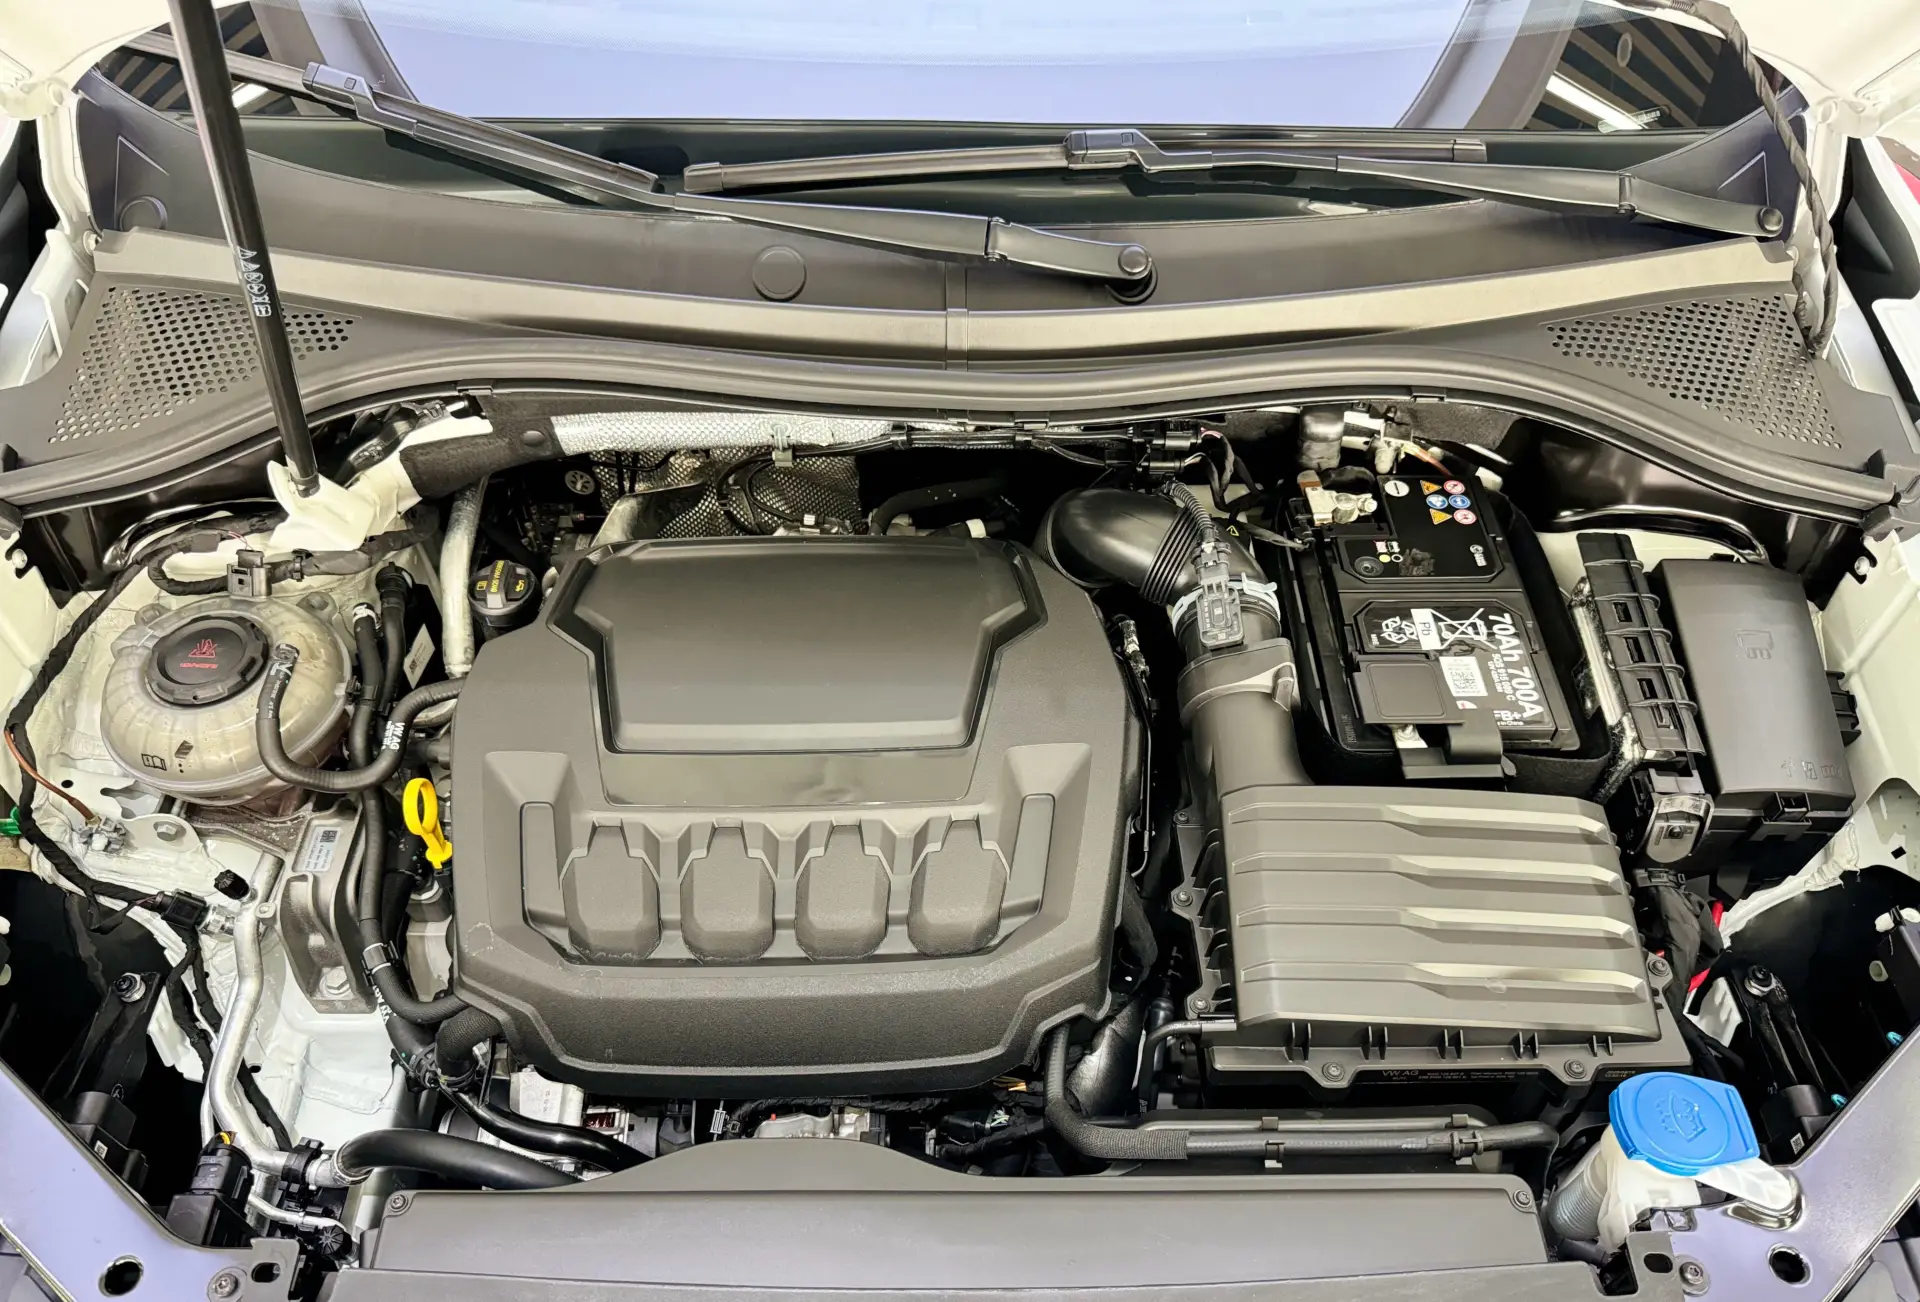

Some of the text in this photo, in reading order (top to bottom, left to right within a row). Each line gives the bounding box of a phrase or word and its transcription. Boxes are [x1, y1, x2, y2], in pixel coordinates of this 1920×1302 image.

[1419, 622, 1431, 635] Pb
[1488, 613, 1544, 718] 70Ah 700A
[1496, 669, 1509, 680] 915
[389, 722, 405, 750] VW AG
